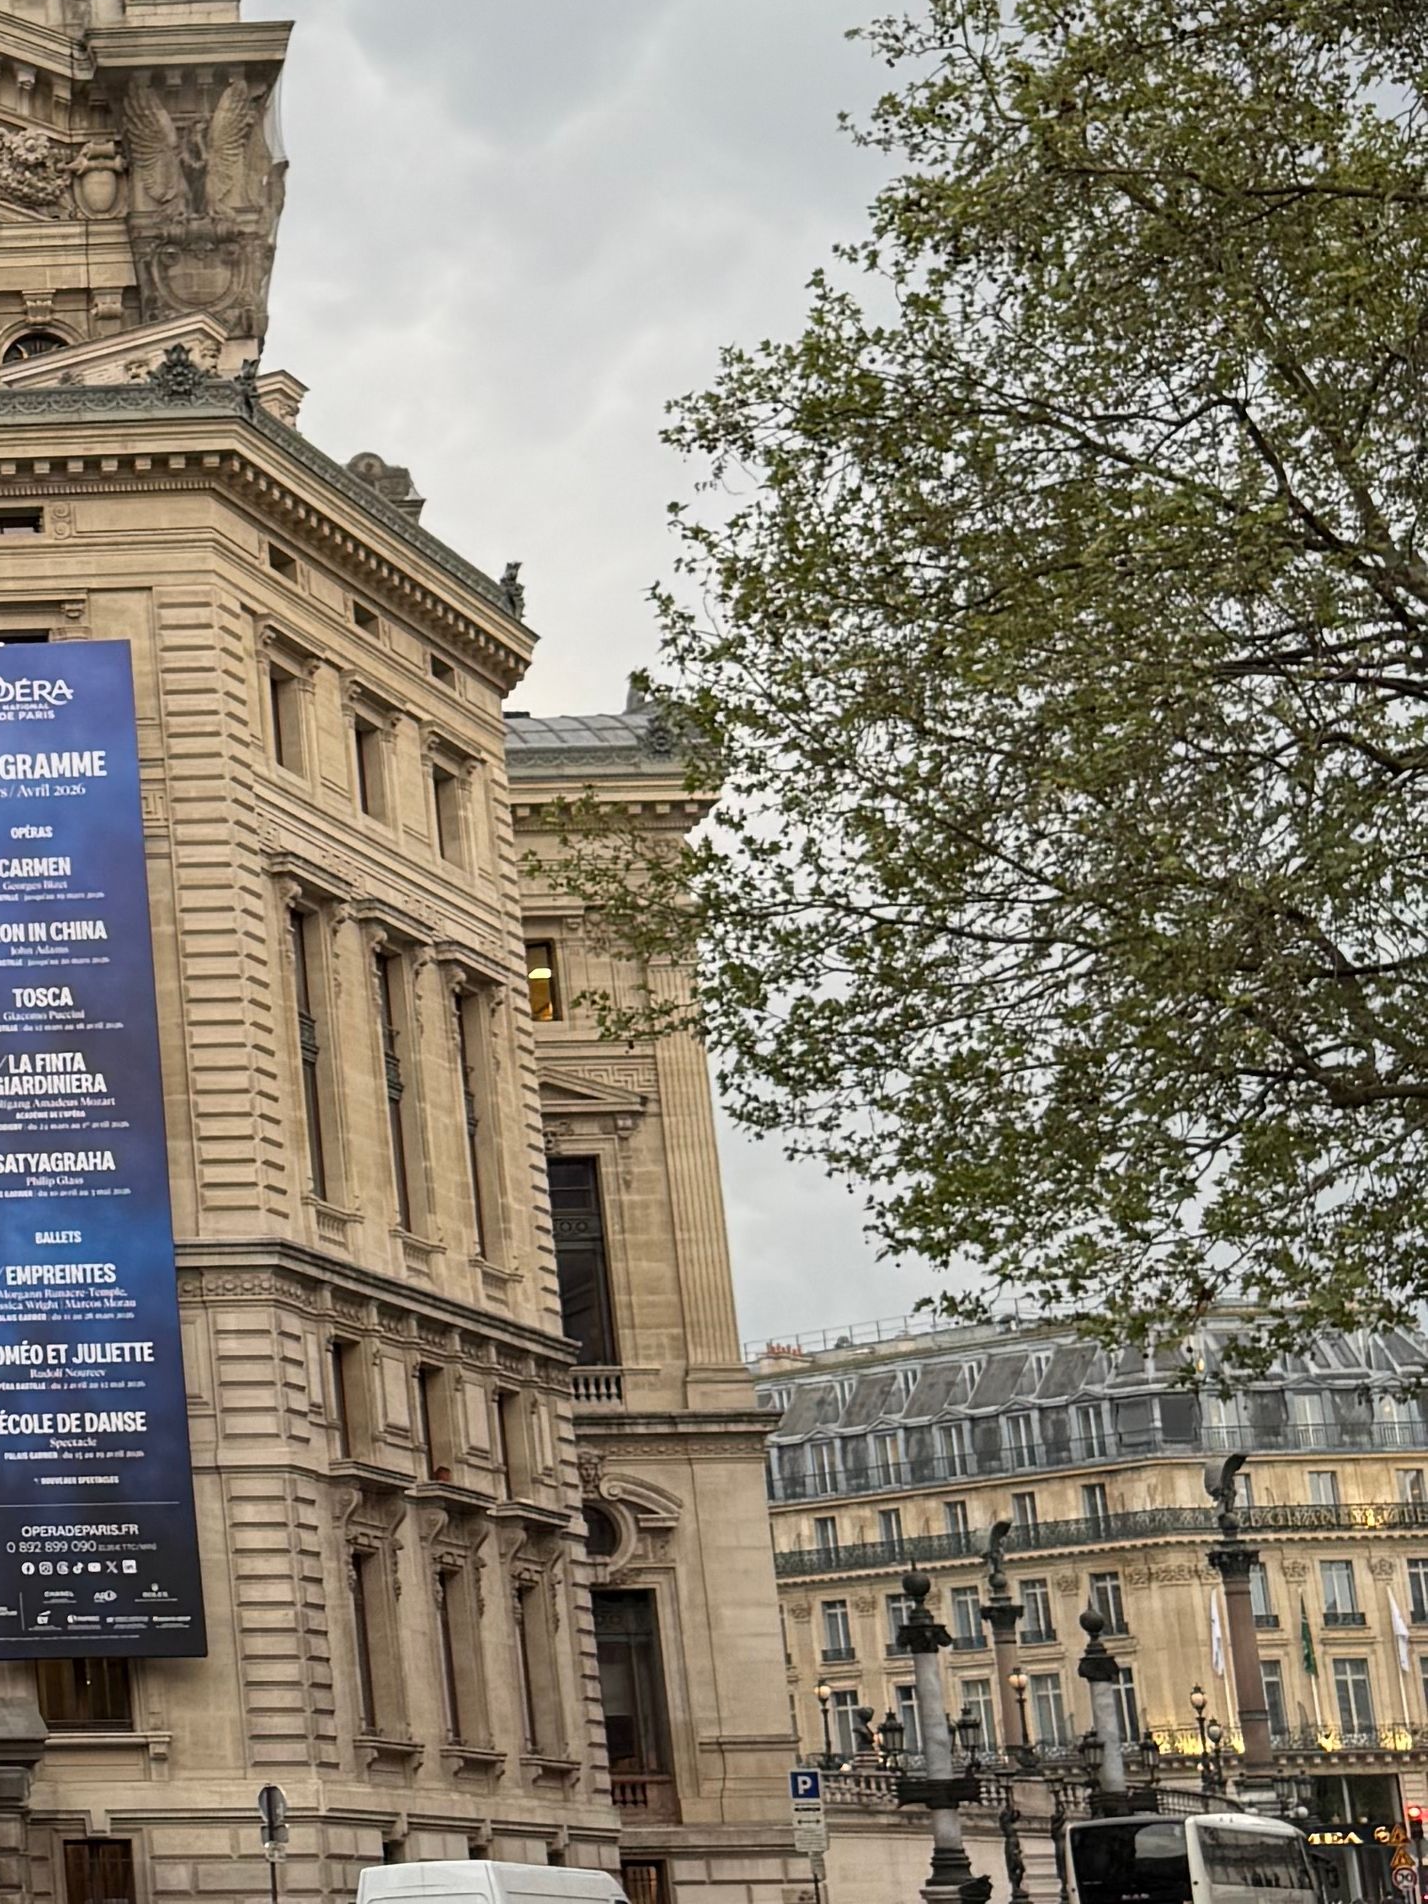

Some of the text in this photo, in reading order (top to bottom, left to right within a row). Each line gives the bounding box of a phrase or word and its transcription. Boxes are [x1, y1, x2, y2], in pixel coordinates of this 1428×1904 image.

[19, 710, 55, 720] PARIS
[17, 784, 50, 797] Avril
[54, 783, 86, 795] 2026
[11, 824, 53, 839] OPÉRAS
[28, 922, 46, 942] IN
[50, 920, 107, 941] CHINA
[12, 987, 74, 1008] TOSCA
[8, 1052, 86, 1074] LA FINTA
[35, 1230, 81, 1245] BALLETS
[5, 1263, 116, 1286] EMPREINTES
[47, 1344, 68, 1365] ET
[72, 1342, 155, 1364] JULIETTE
[57, 1412, 81, 1434] DE
[84, 1411, 147, 1433] DANSE
[21, 1524, 139, 1537] OPERADEPARIS.FR
[19, 1541, 41, 1553] 892
[45, 1541, 68, 1552] 899
[71, 1540, 97, 1552] 090
[797, 1776, 813, 1795] P
